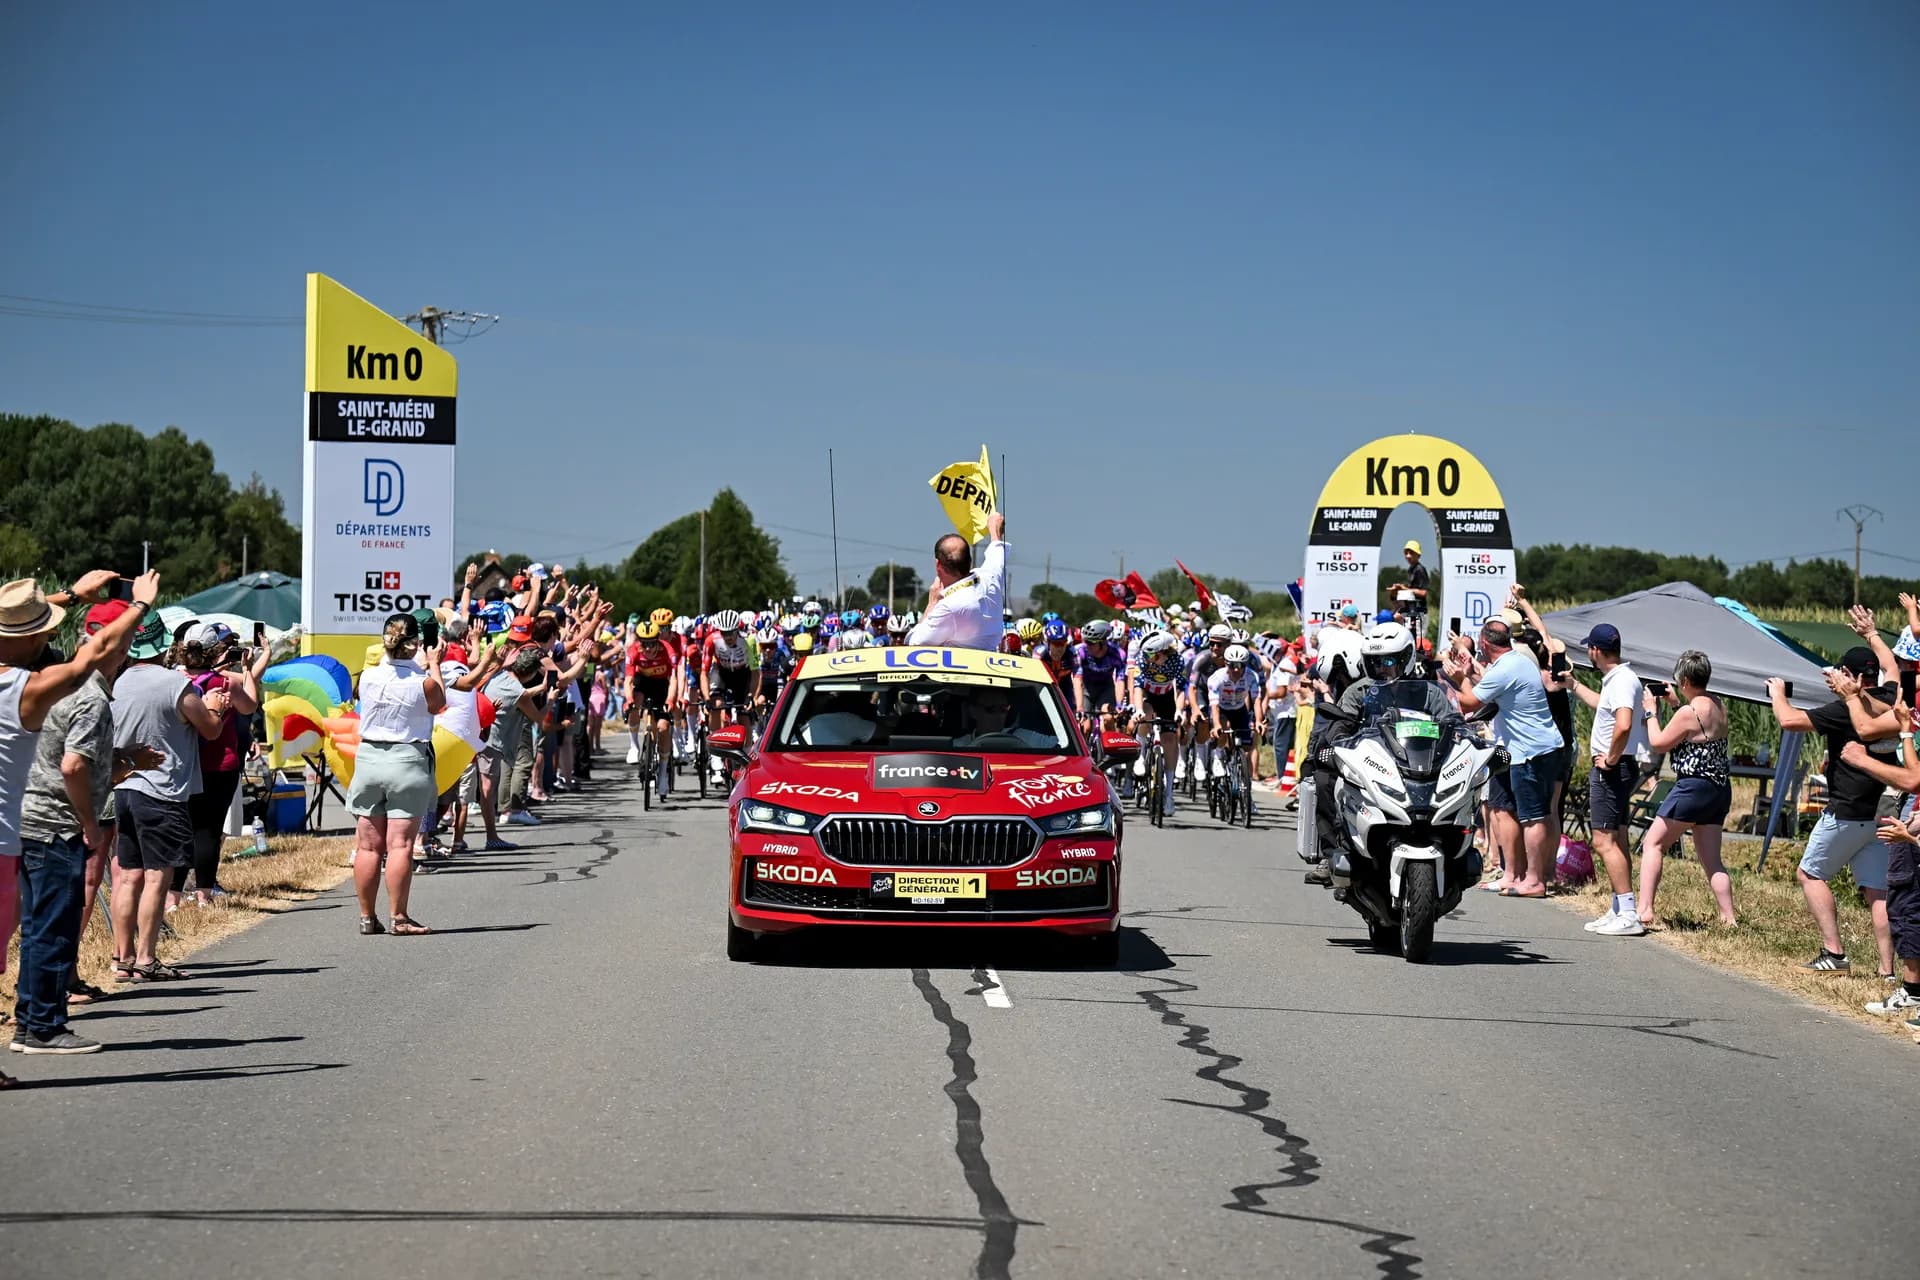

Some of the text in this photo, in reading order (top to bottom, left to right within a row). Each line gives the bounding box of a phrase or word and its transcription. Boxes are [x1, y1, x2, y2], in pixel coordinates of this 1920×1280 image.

[347, 345, 423, 381] Km 0
[338, 398, 435, 419] SAINT-MÉEN
[347, 420, 426, 437] LE-GRAND
[1365, 457, 1460, 497] Km 0
[1323, 508, 1377, 519] SAINT-MÉEN
[1446, 509, 1500, 520] SAINT-MÉEN
[336, 520, 431, 537] DÉPARTEMENTS
[1328, 521, 1372, 531] LE-GRAND
[1451, 523, 1494, 533] LE-GRAND
[361, 540, 405, 549] DE FRANCE
[1316, 562, 1368, 572] TISSOT
[1455, 565, 1506, 575] TISSOT
[334, 593, 431, 612] TISSOT
[1311, 612, 1372, 623] TIST
[832, 655, 866, 665] LCL
[885, 649, 968, 669] LCL
[989, 657, 1022, 668] LCL
[762, 843, 798, 855] HYBRID
[1061, 848, 1096, 859] HYBRID
[898, 877, 980, 893] DIRECTION 1
[898, 885, 959, 893] GÉNÉRALE
